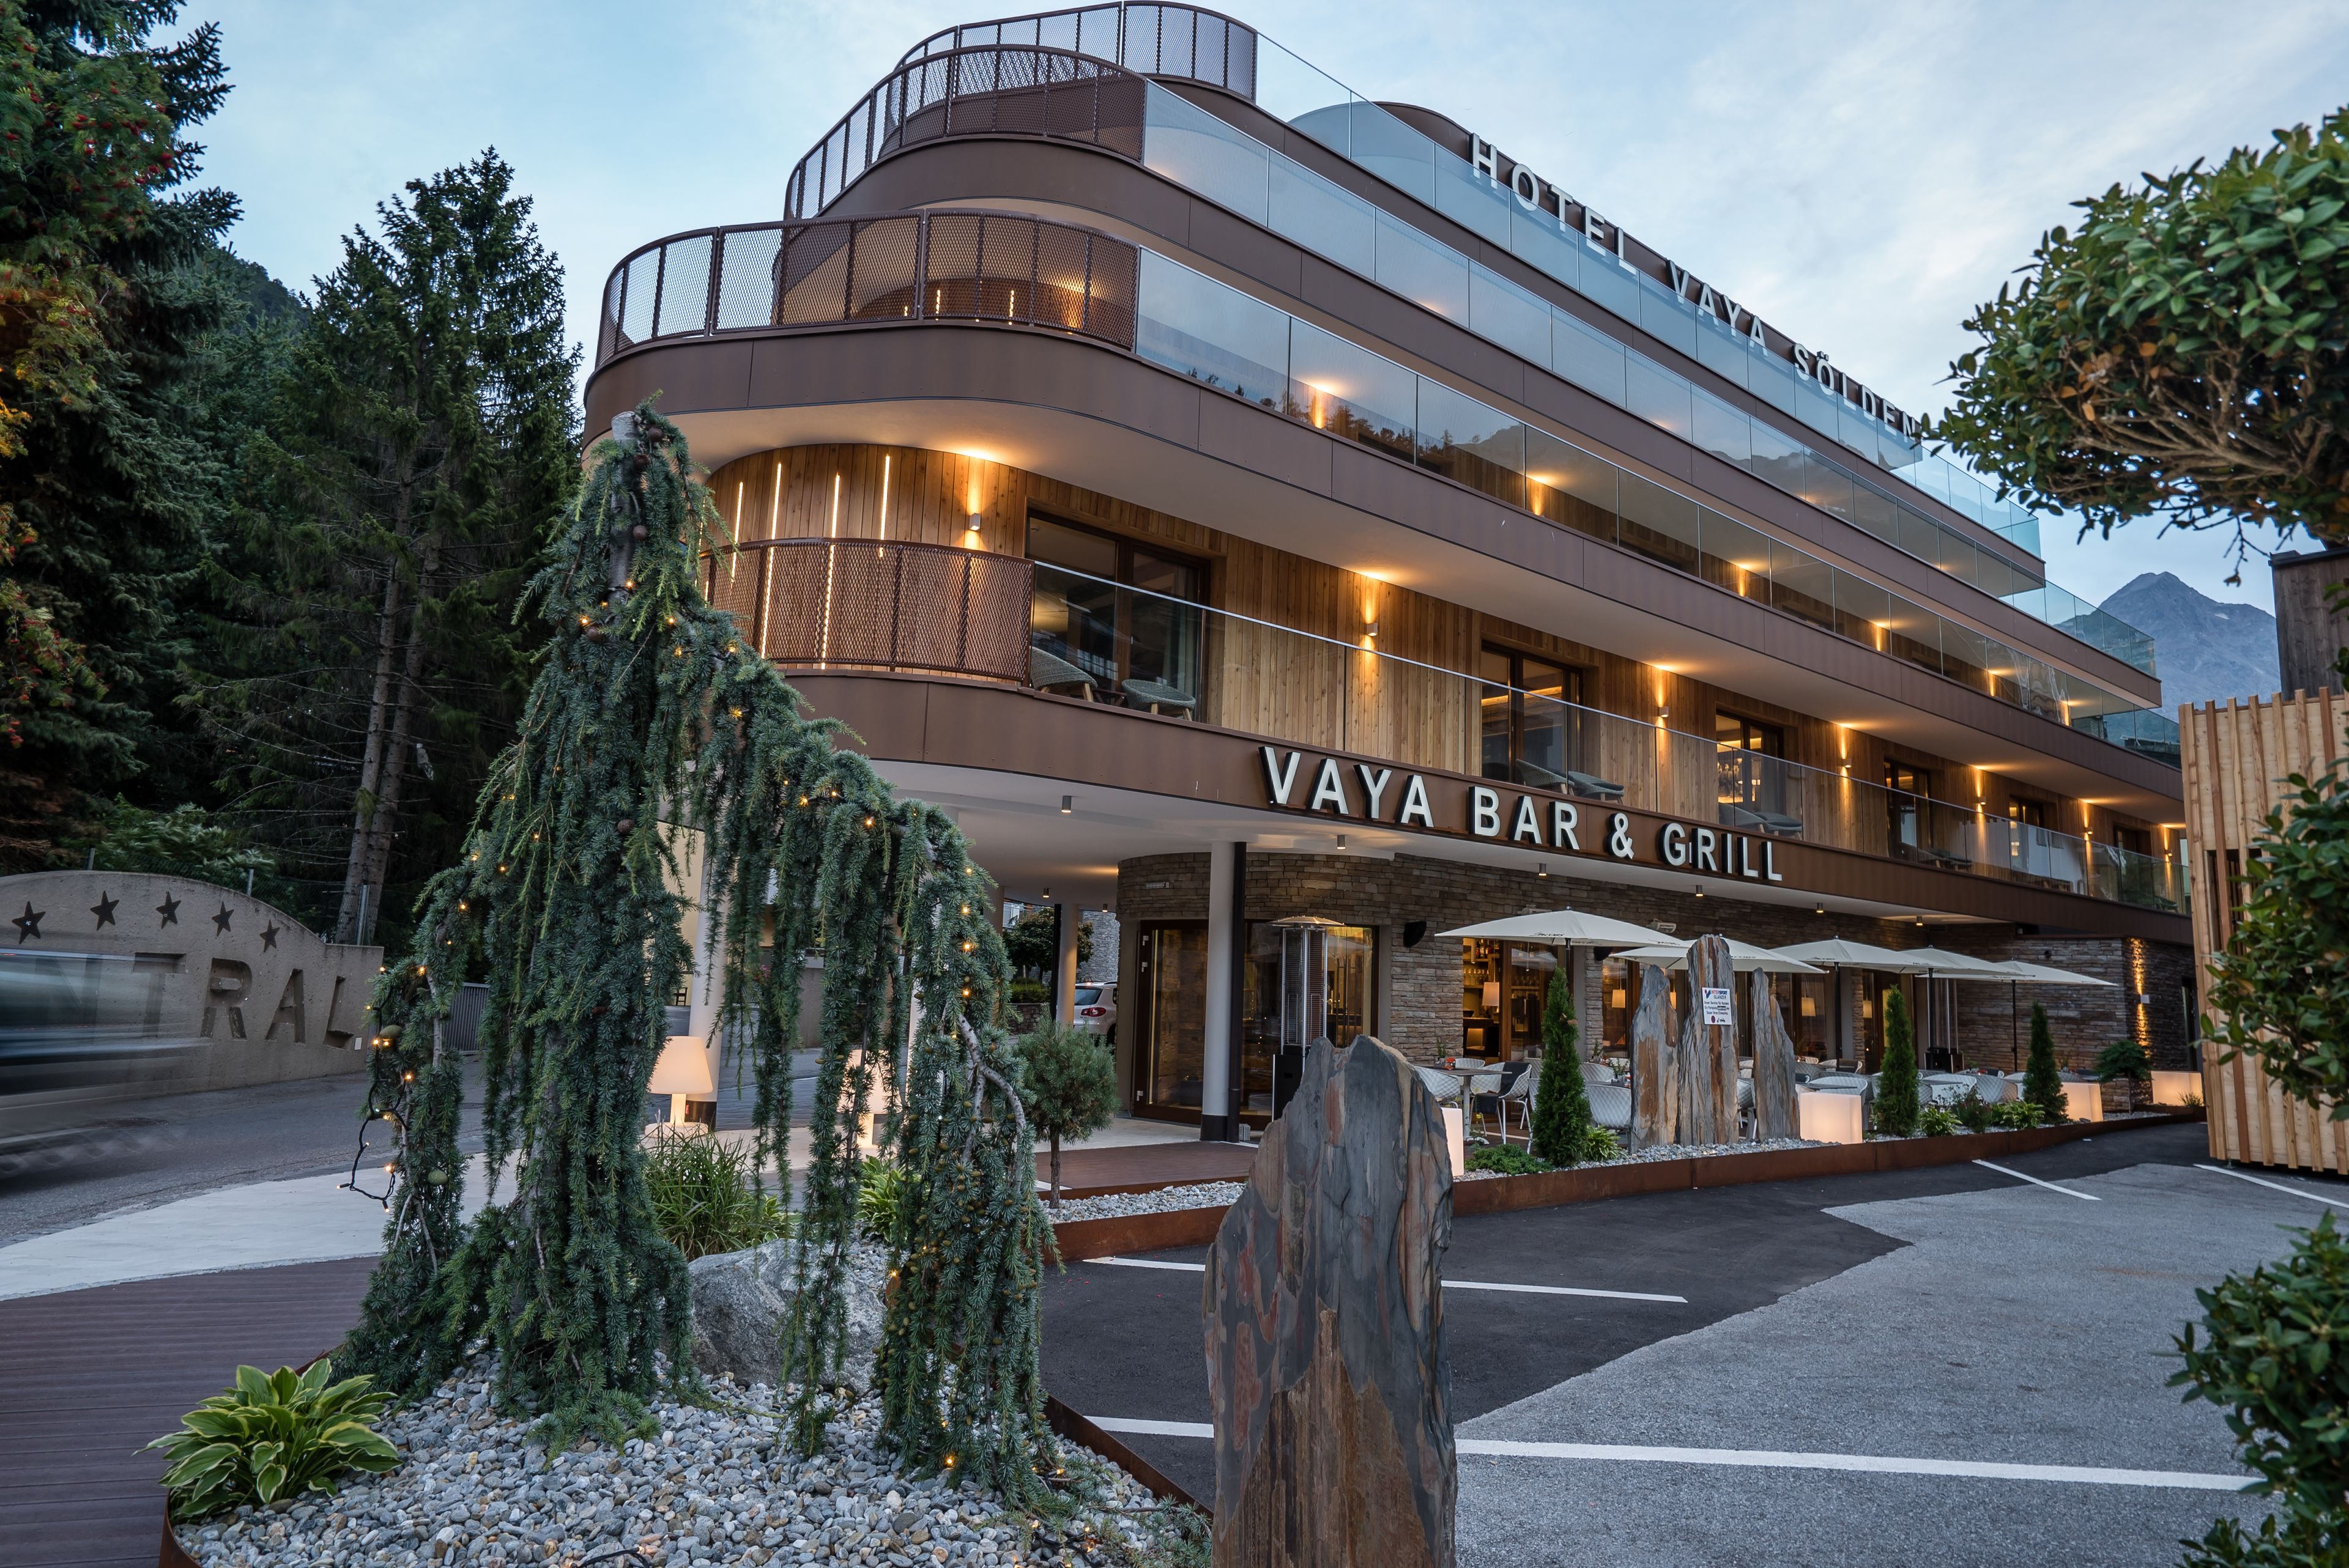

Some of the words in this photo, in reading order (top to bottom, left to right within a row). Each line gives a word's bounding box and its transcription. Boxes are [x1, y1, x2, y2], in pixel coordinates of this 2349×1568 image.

[1470, 133, 1636, 275] HOTEL
[1667, 260, 1768, 357] VAYA
[1792, 344, 1916, 443] SÖLDEN
[1258, 745, 1434, 827] VAYA
[1469, 785, 1579, 850] BAR
[1606, 812, 1635, 859] &
[1659, 823, 1783, 881] GRILL
